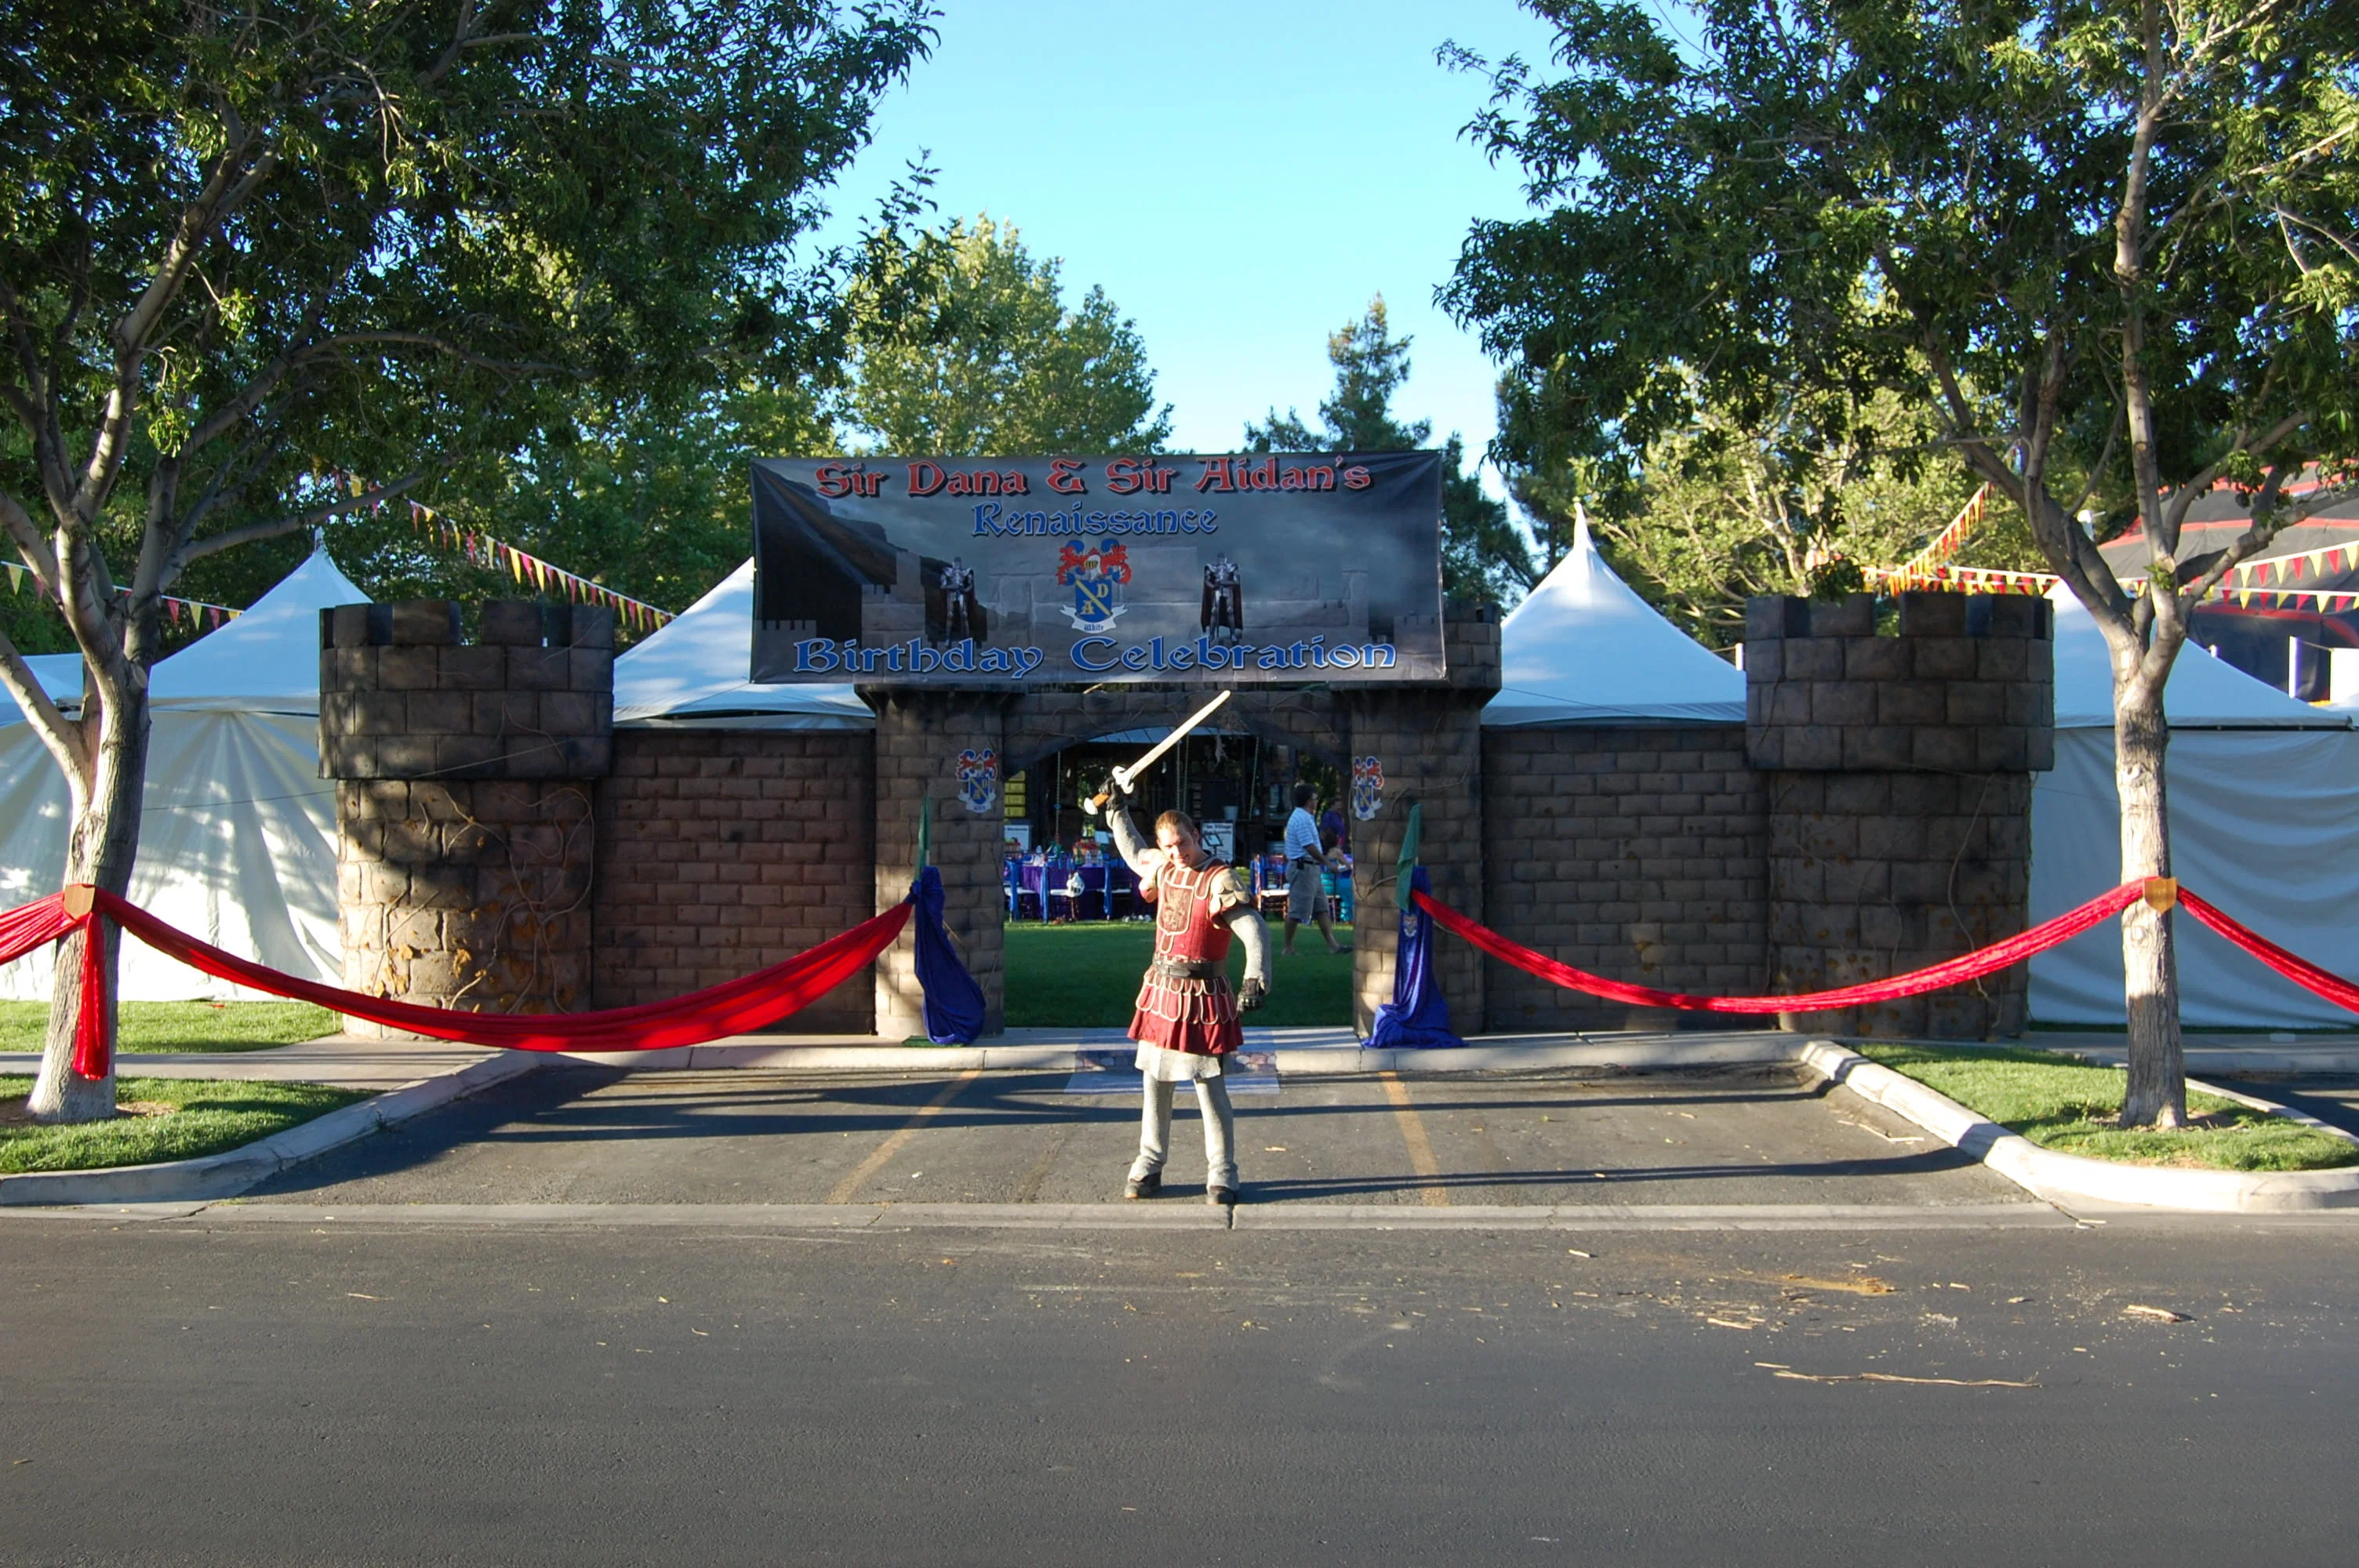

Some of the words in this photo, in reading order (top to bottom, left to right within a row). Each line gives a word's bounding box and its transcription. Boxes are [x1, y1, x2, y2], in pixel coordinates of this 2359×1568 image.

[815, 461, 886, 496] Sir
[906, 459, 1029, 496] Dana
[1045, 458, 1086, 494] &
[1105, 458, 1178, 495] Sir
[1193, 455, 1372, 492] Aidan's
[971, 500, 1218, 537] Renaissance
[1080, 600, 1096, 615] A
[1096, 583, 1109, 598] D
[793, 637, 1044, 680] Birthday
[1070, 634, 1398, 672] Celebration
